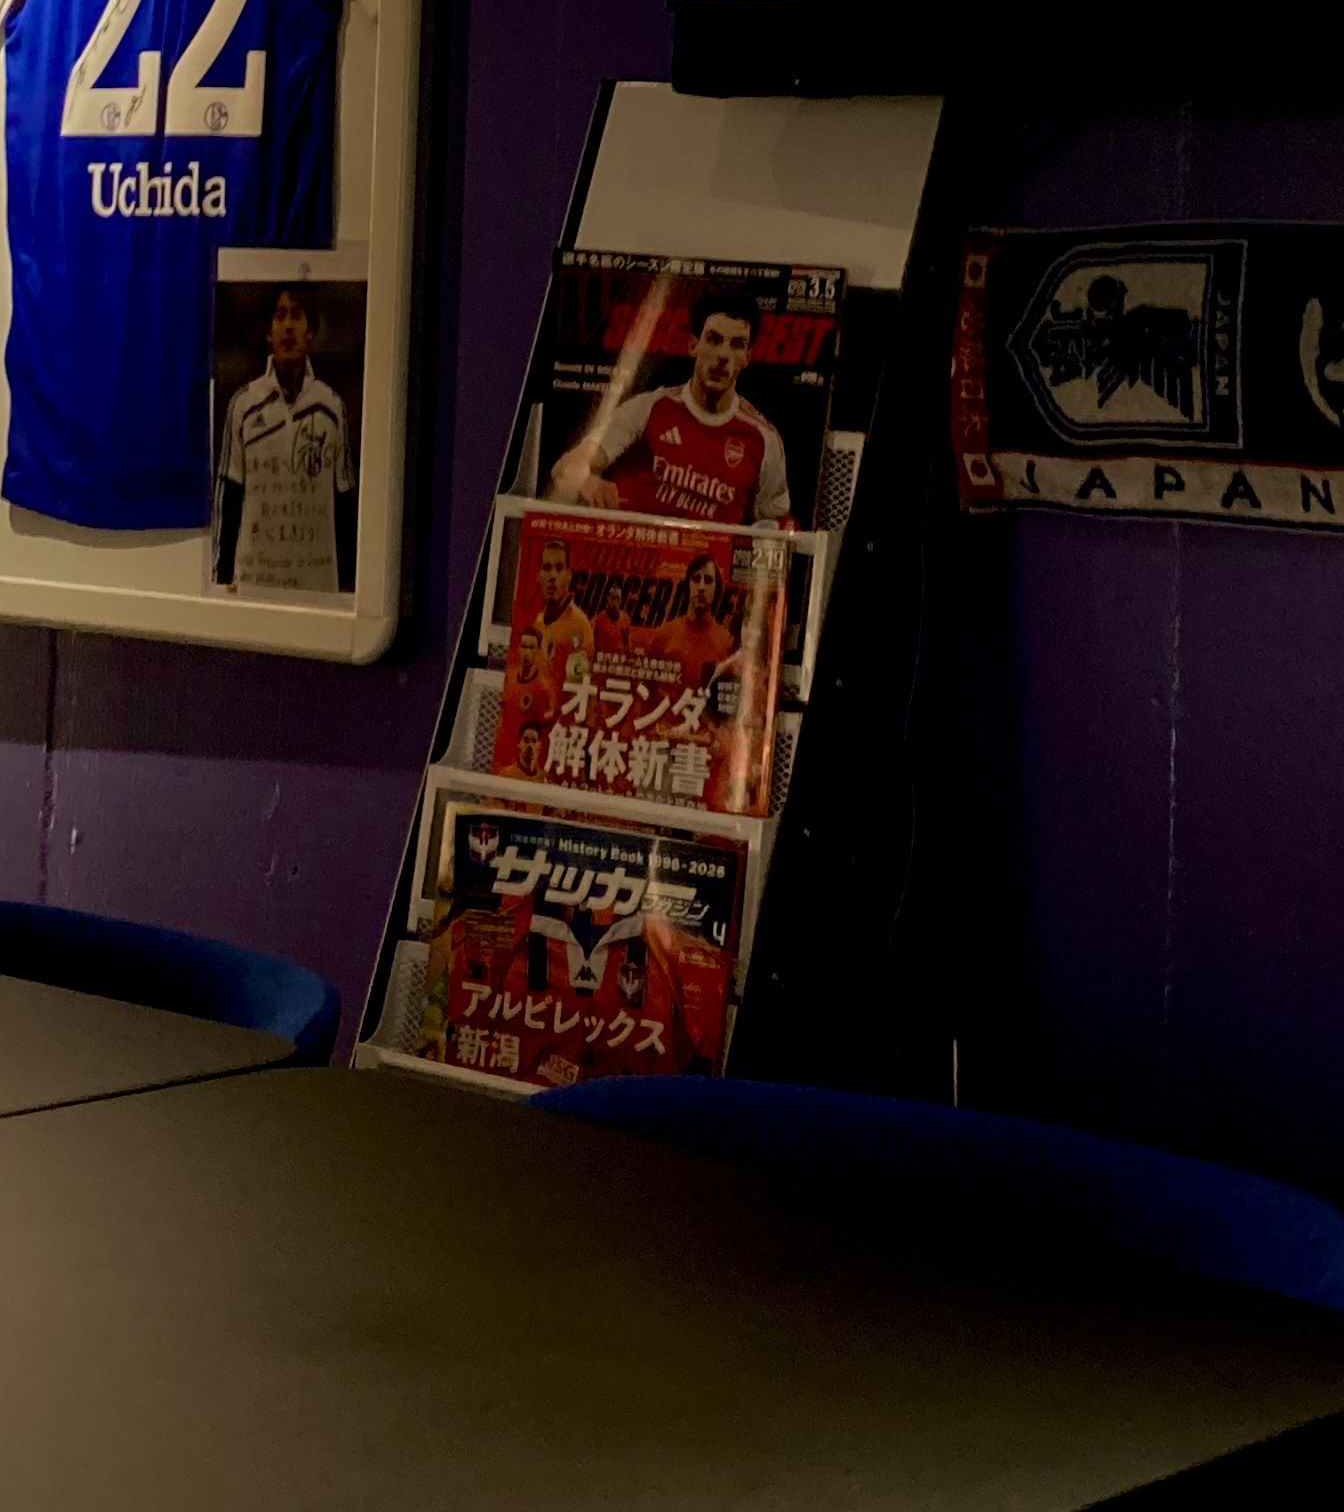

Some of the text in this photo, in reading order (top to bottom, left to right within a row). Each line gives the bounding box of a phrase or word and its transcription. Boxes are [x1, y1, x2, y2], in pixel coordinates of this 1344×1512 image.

[87, 160, 227, 218] Uchida
[1212, 289, 1233, 397] JAPAN
[652, 454, 737, 505] Emirates
[1018, 460, 1337, 516] JAPAN
[560, 673, 712, 733] オランダ
[543, 721, 713, 798] 解体新書
[488, 844, 698, 917] サッカー
[558, 839, 608, 861] History
[609, 847, 646, 867] Book
[461, 980, 667, 1056] アルビレックス
[456, 1023, 521, 1074] 新潟
